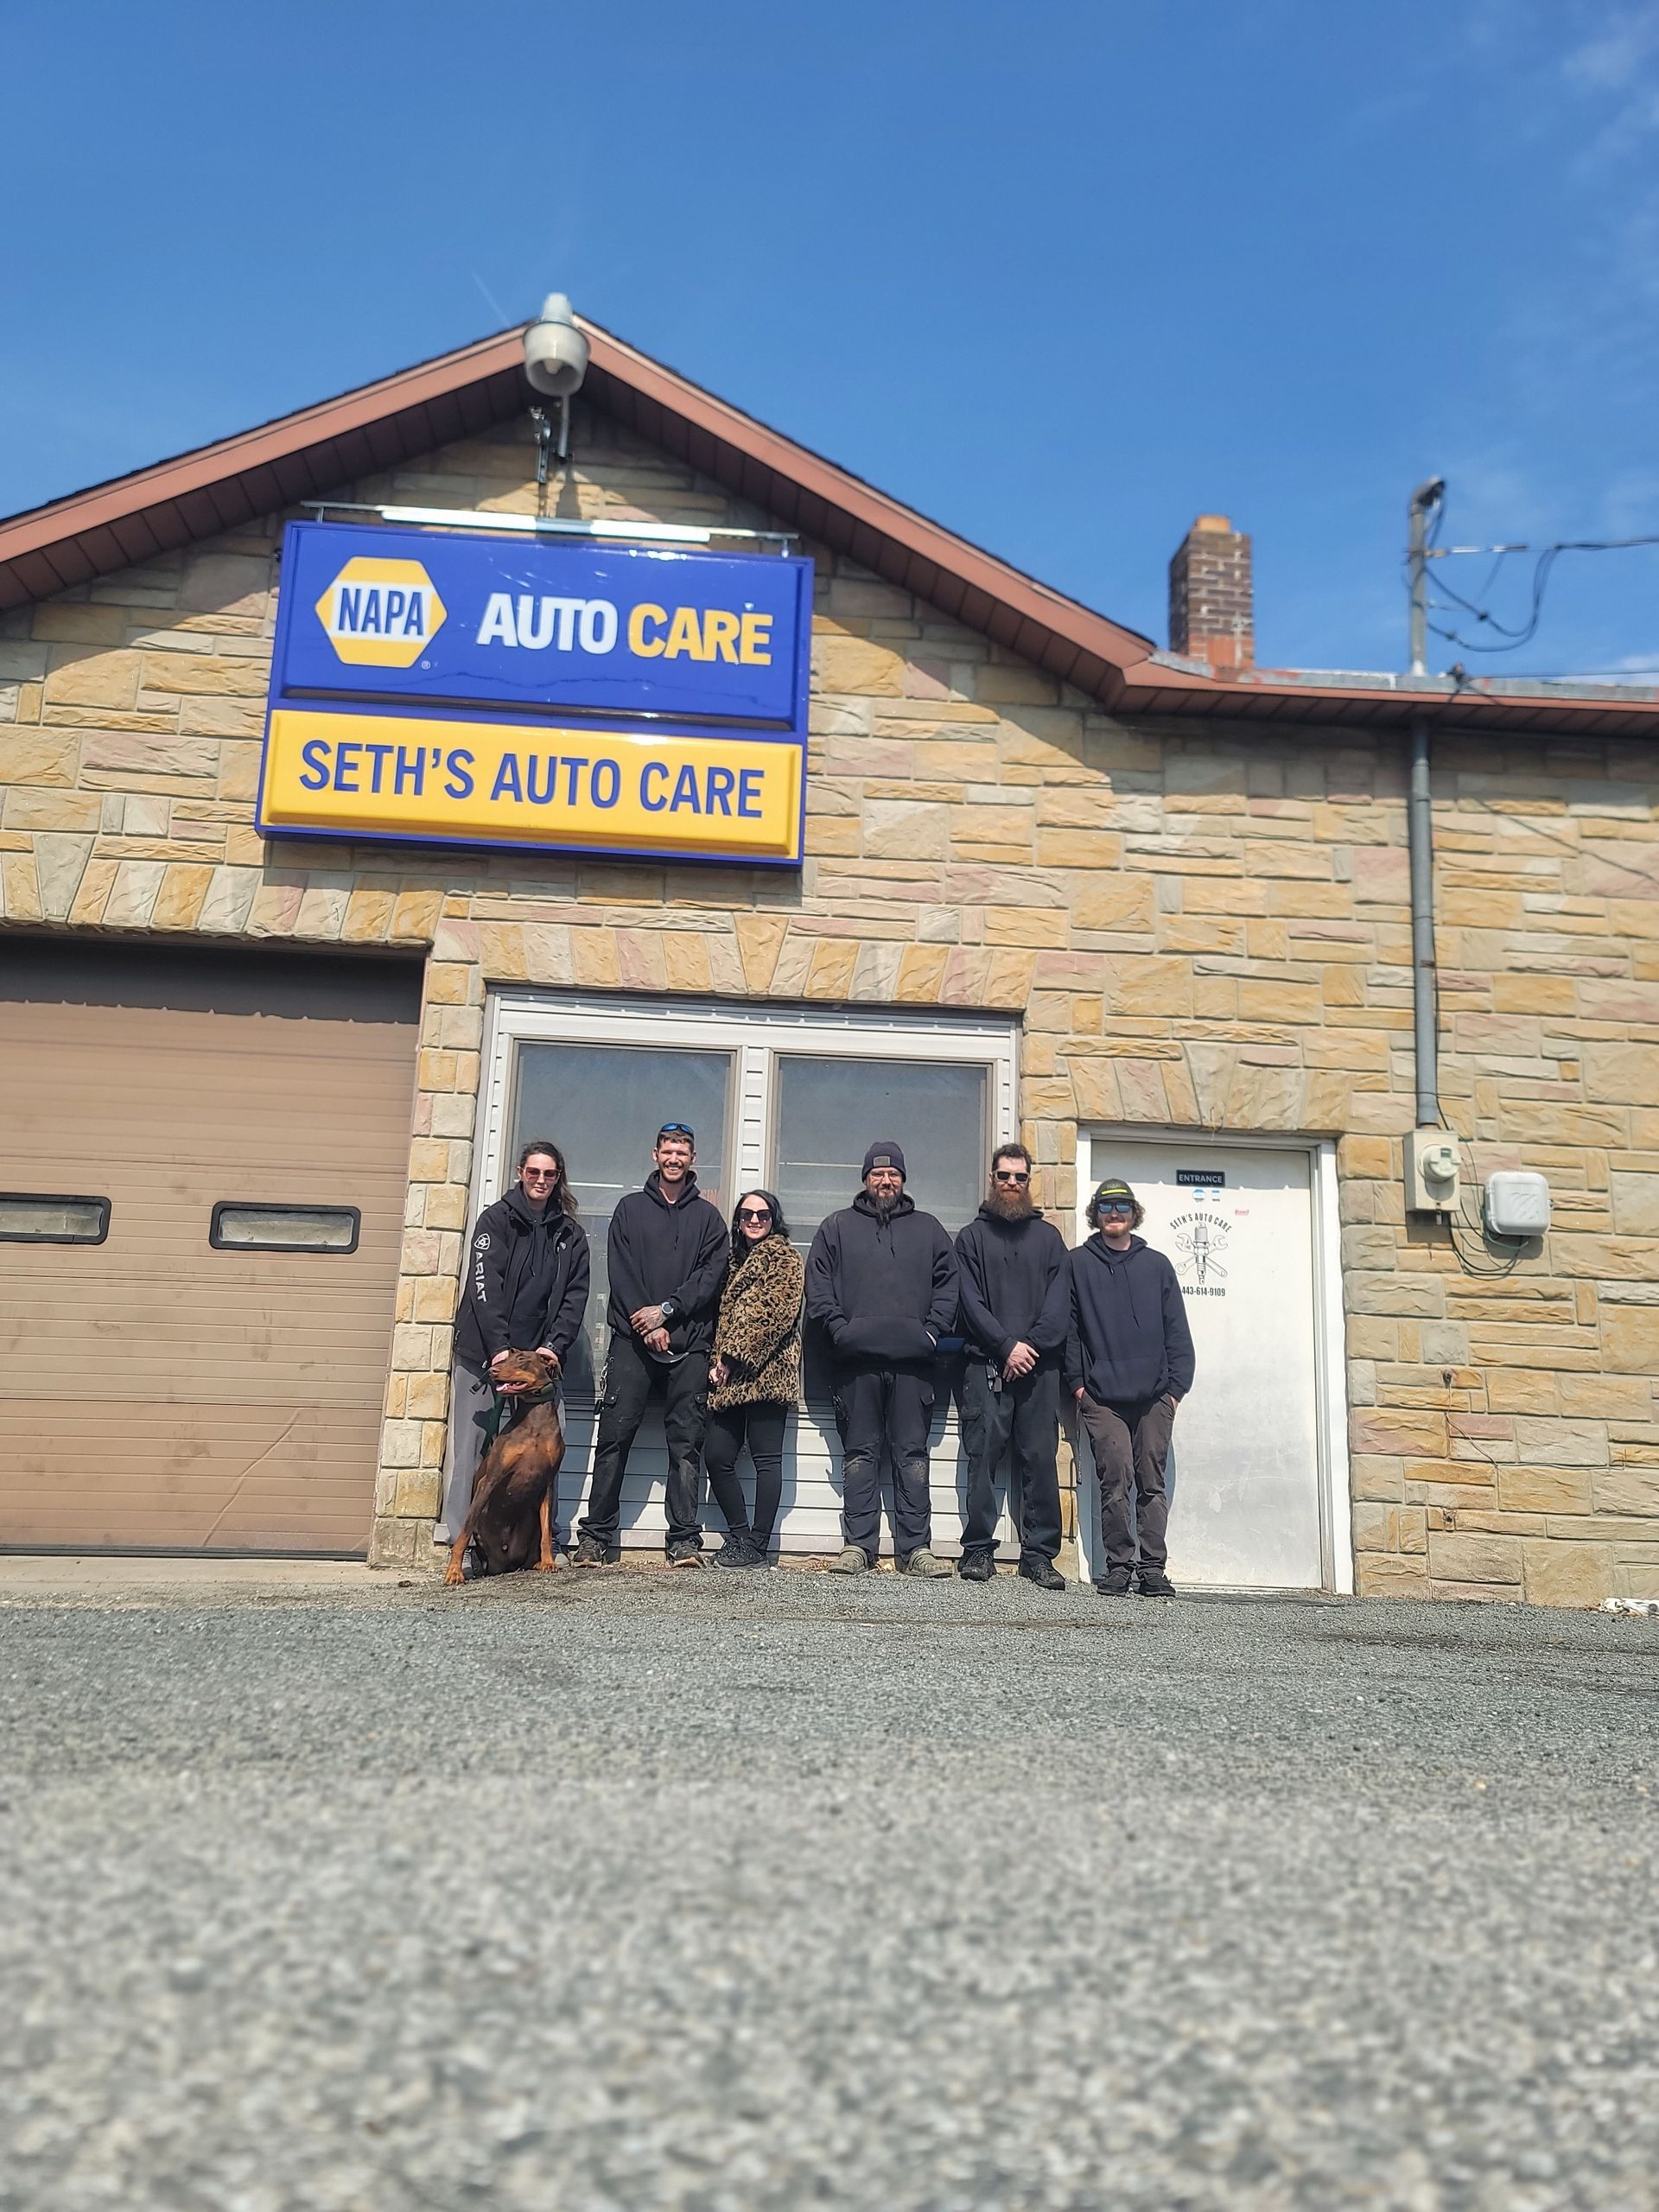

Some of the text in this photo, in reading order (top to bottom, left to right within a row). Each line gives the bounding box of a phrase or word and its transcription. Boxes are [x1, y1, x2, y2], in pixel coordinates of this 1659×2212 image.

[338, 588, 424, 636] NAPA
[477, 592, 773, 665] AUTO CARE
[299, 740, 766, 818] SETH'S AUTO CARE
[1179, 1174, 1223, 1184] ENTRANCE
[1170, 1212, 1232, 1232] SETH'S AUTO CARE
[475, 1251, 486, 1302] ARIAT
[1182, 1286, 1225, 1297] 443-614-9109
